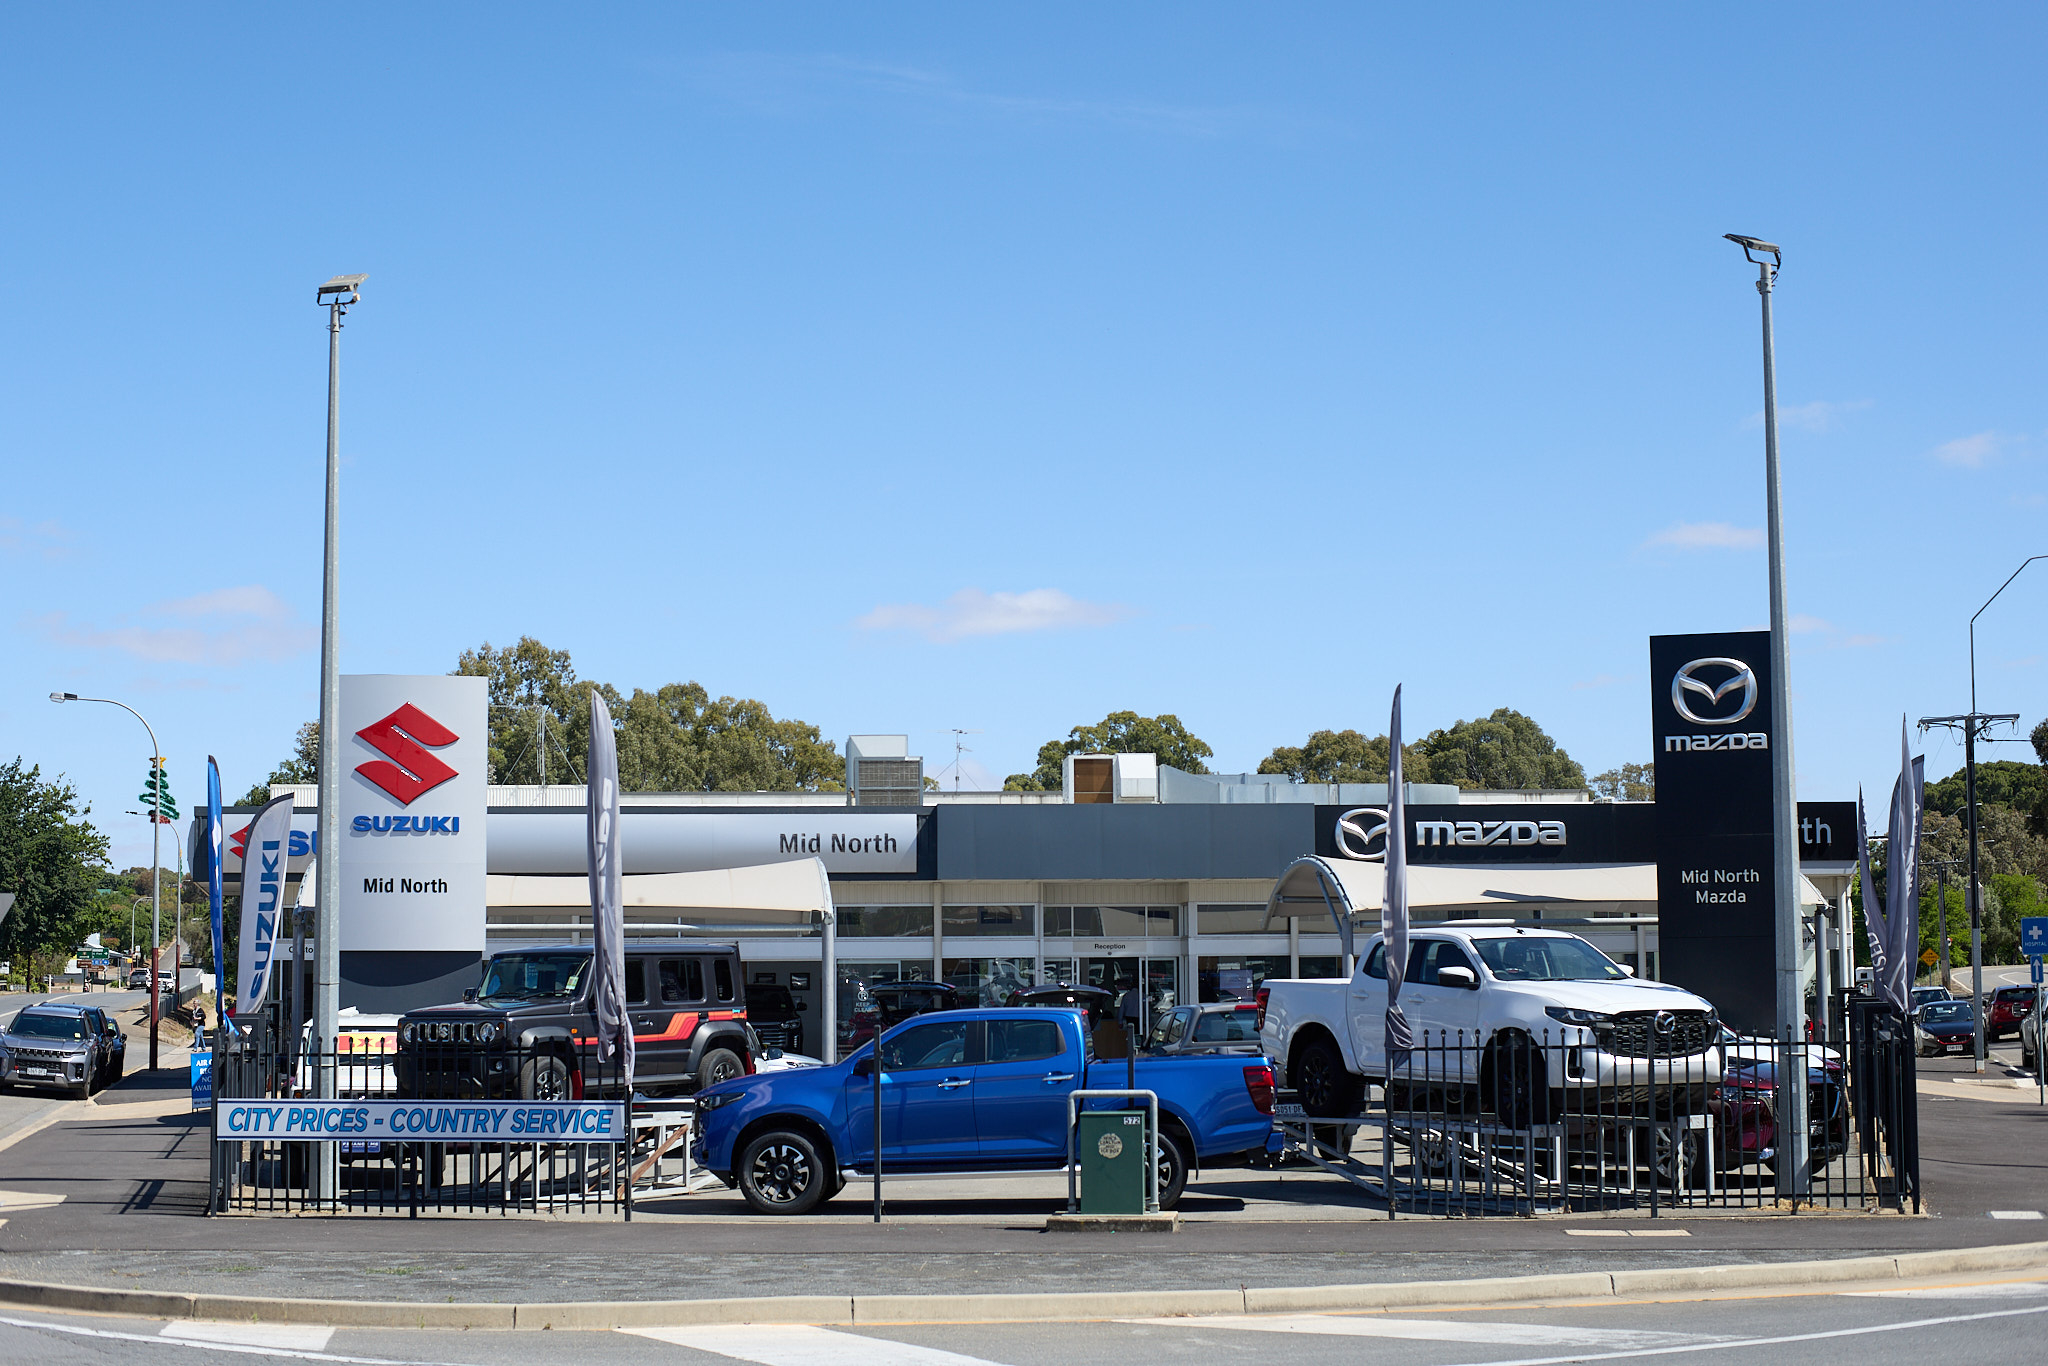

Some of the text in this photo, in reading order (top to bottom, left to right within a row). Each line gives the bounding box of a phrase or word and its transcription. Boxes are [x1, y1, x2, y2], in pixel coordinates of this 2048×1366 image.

[353, 816, 460, 832] SUZUKI
[779, 833, 897, 854] Mid North
[1681, 868, 1760, 884] Mid North
[363, 878, 448, 893] Mid North
[1695, 889, 1746, 904] Mazda
[251, 840, 280, 998] SUZUKI
[1867, 931, 1887, 971] SED
[228, 1107, 284, 1132] CITY
[285, 1107, 369, 1132] PRICES
[390, 1107, 509, 1133] COUNTRY
[510, 1108, 614, 1134] SERVICE
